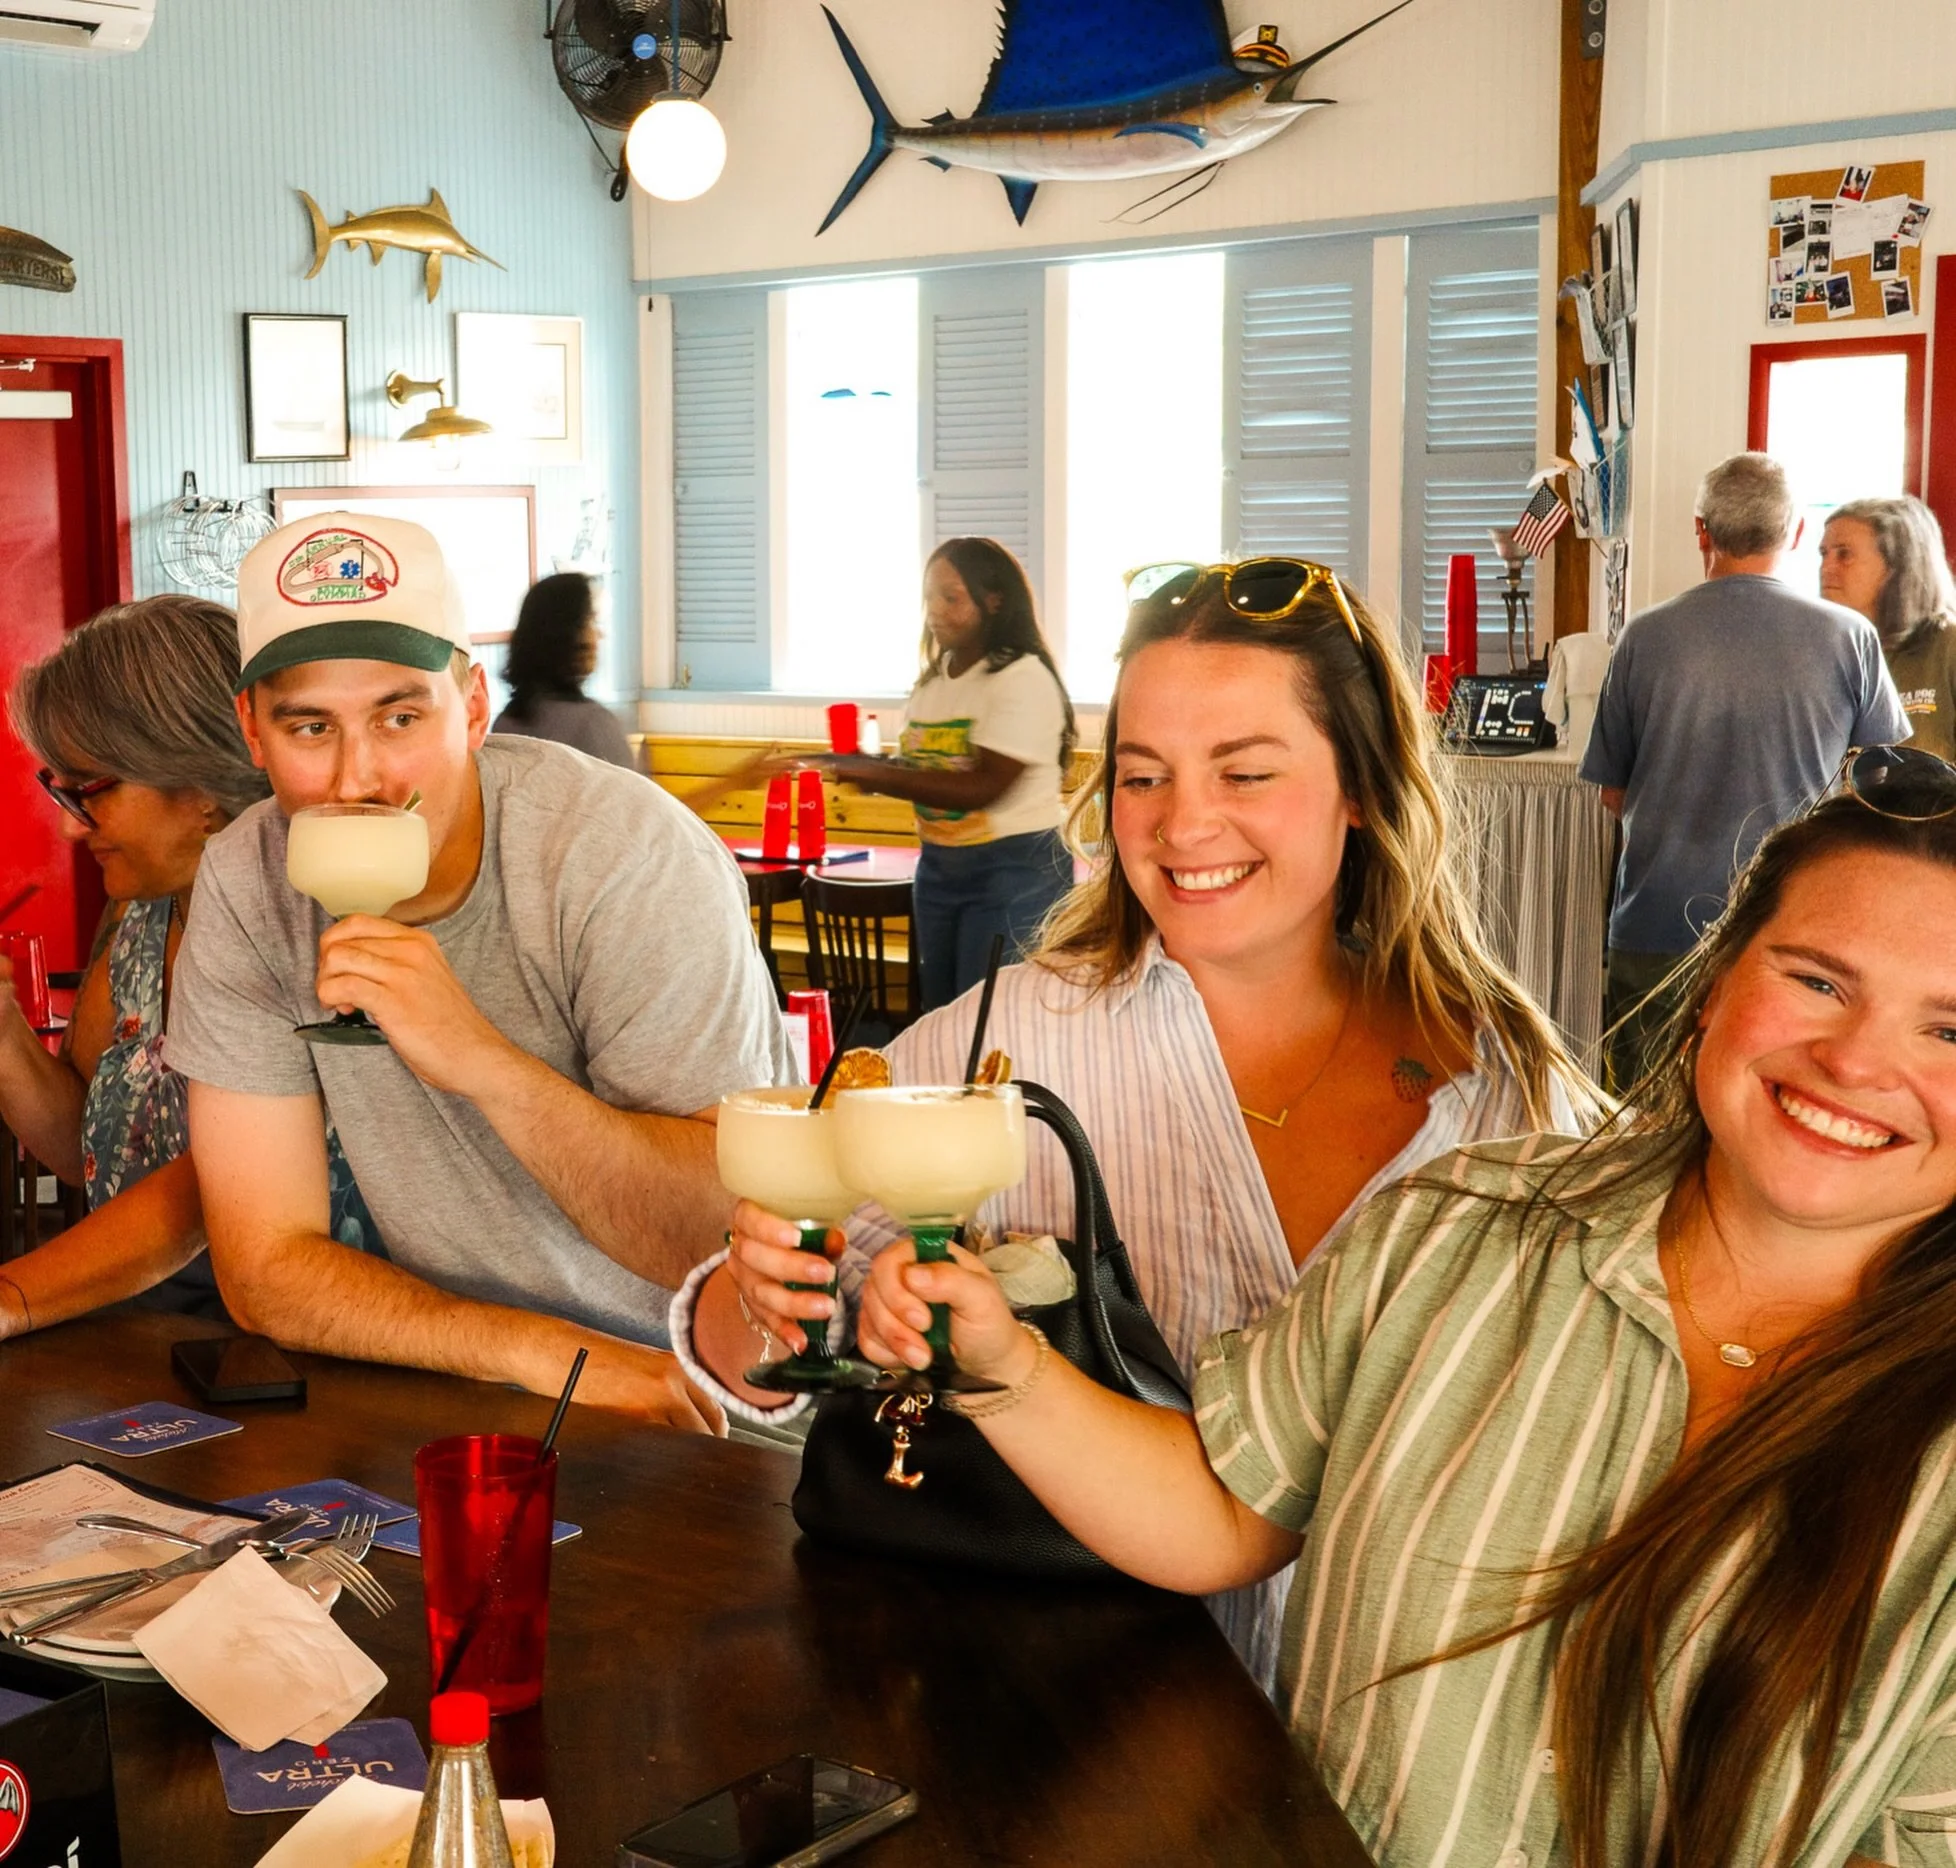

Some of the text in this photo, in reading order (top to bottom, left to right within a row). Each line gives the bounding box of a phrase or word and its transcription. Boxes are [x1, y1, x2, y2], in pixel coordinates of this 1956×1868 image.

[110, 1419, 198, 1441] ULTRA
[294, 1756, 352, 1767] ZERO
[256, 1760, 394, 1784] ULTRA
[286, 1775, 348, 1793] chelob
